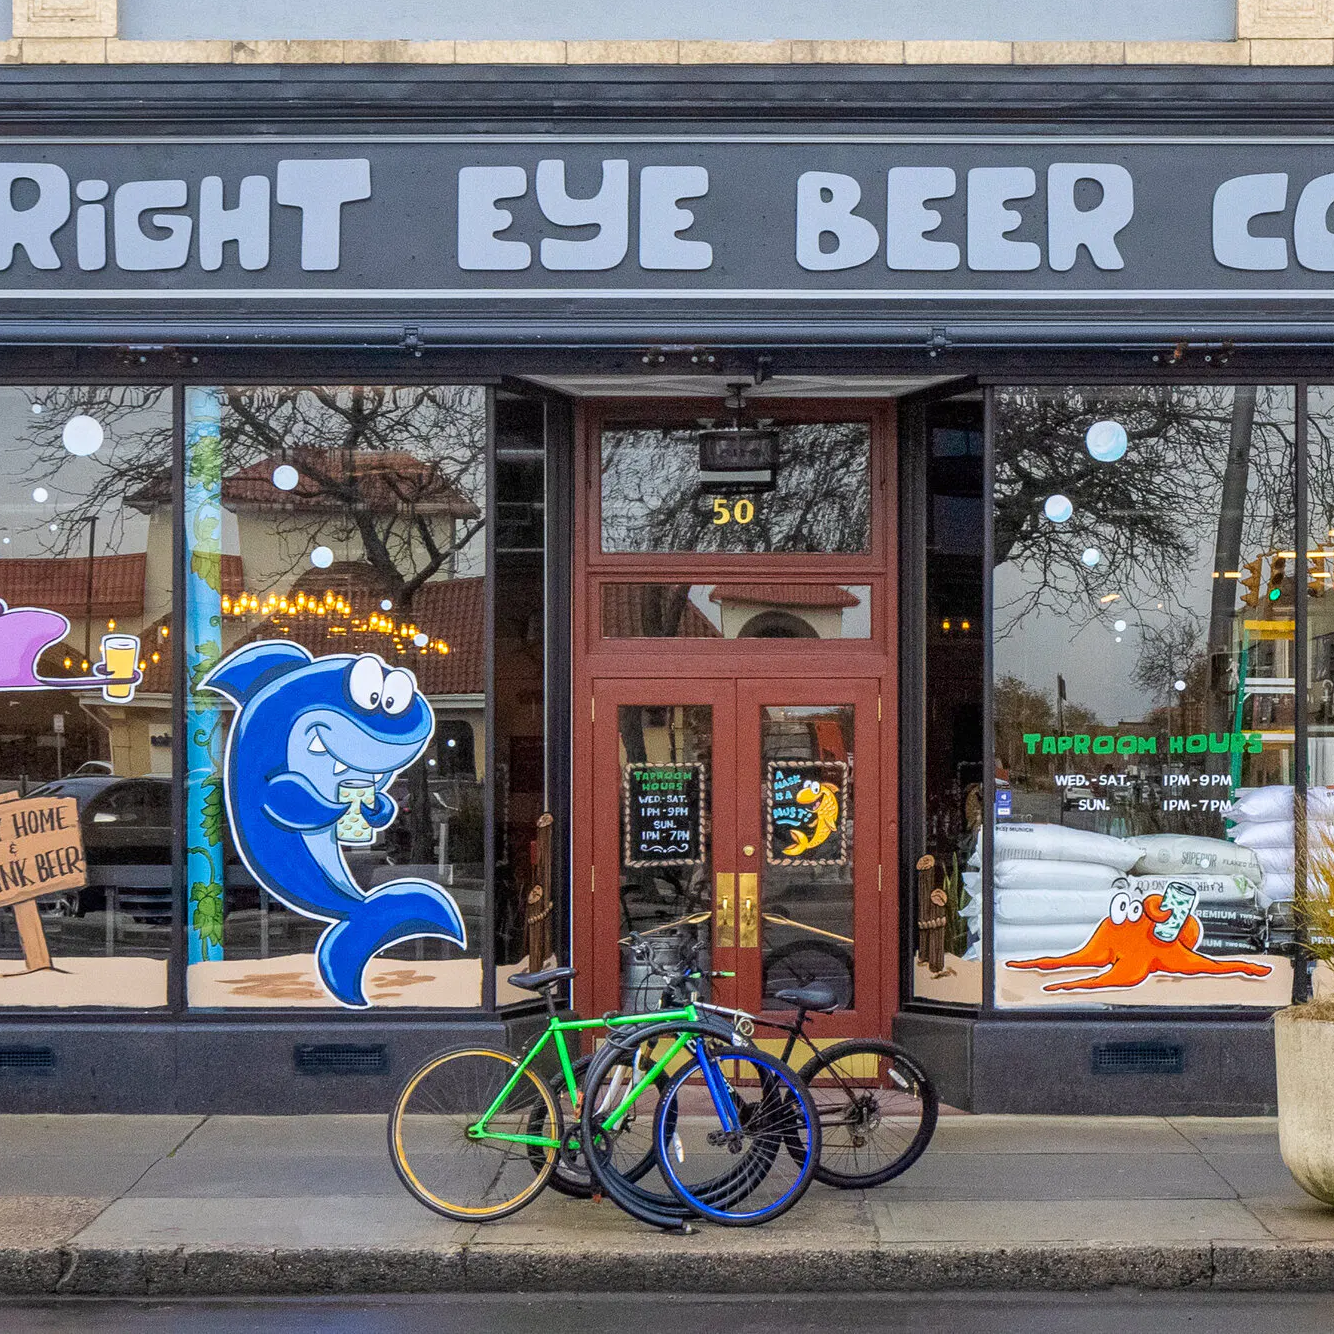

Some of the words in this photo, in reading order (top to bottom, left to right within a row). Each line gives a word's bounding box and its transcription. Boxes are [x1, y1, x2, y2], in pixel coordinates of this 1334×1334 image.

[457, 159, 715, 271] EYE
[795, 162, 1135, 271] BEER
[712, 498, 755, 525] 50
[1023, 733, 1157, 754] TAPROOM
[1169, 733, 1263, 754] HOURS
[633, 770, 692, 781] TAPROOM
[776, 770, 784, 780] A
[642, 782, 684, 791] HOURS
[785, 790, 793, 800] A
[1078, 800, 1110, 812] SUN.
[11, 805, 70, 839] HOME
[653, 820, 677, 829] SUN.
[34, 845, 84, 883] BEER
